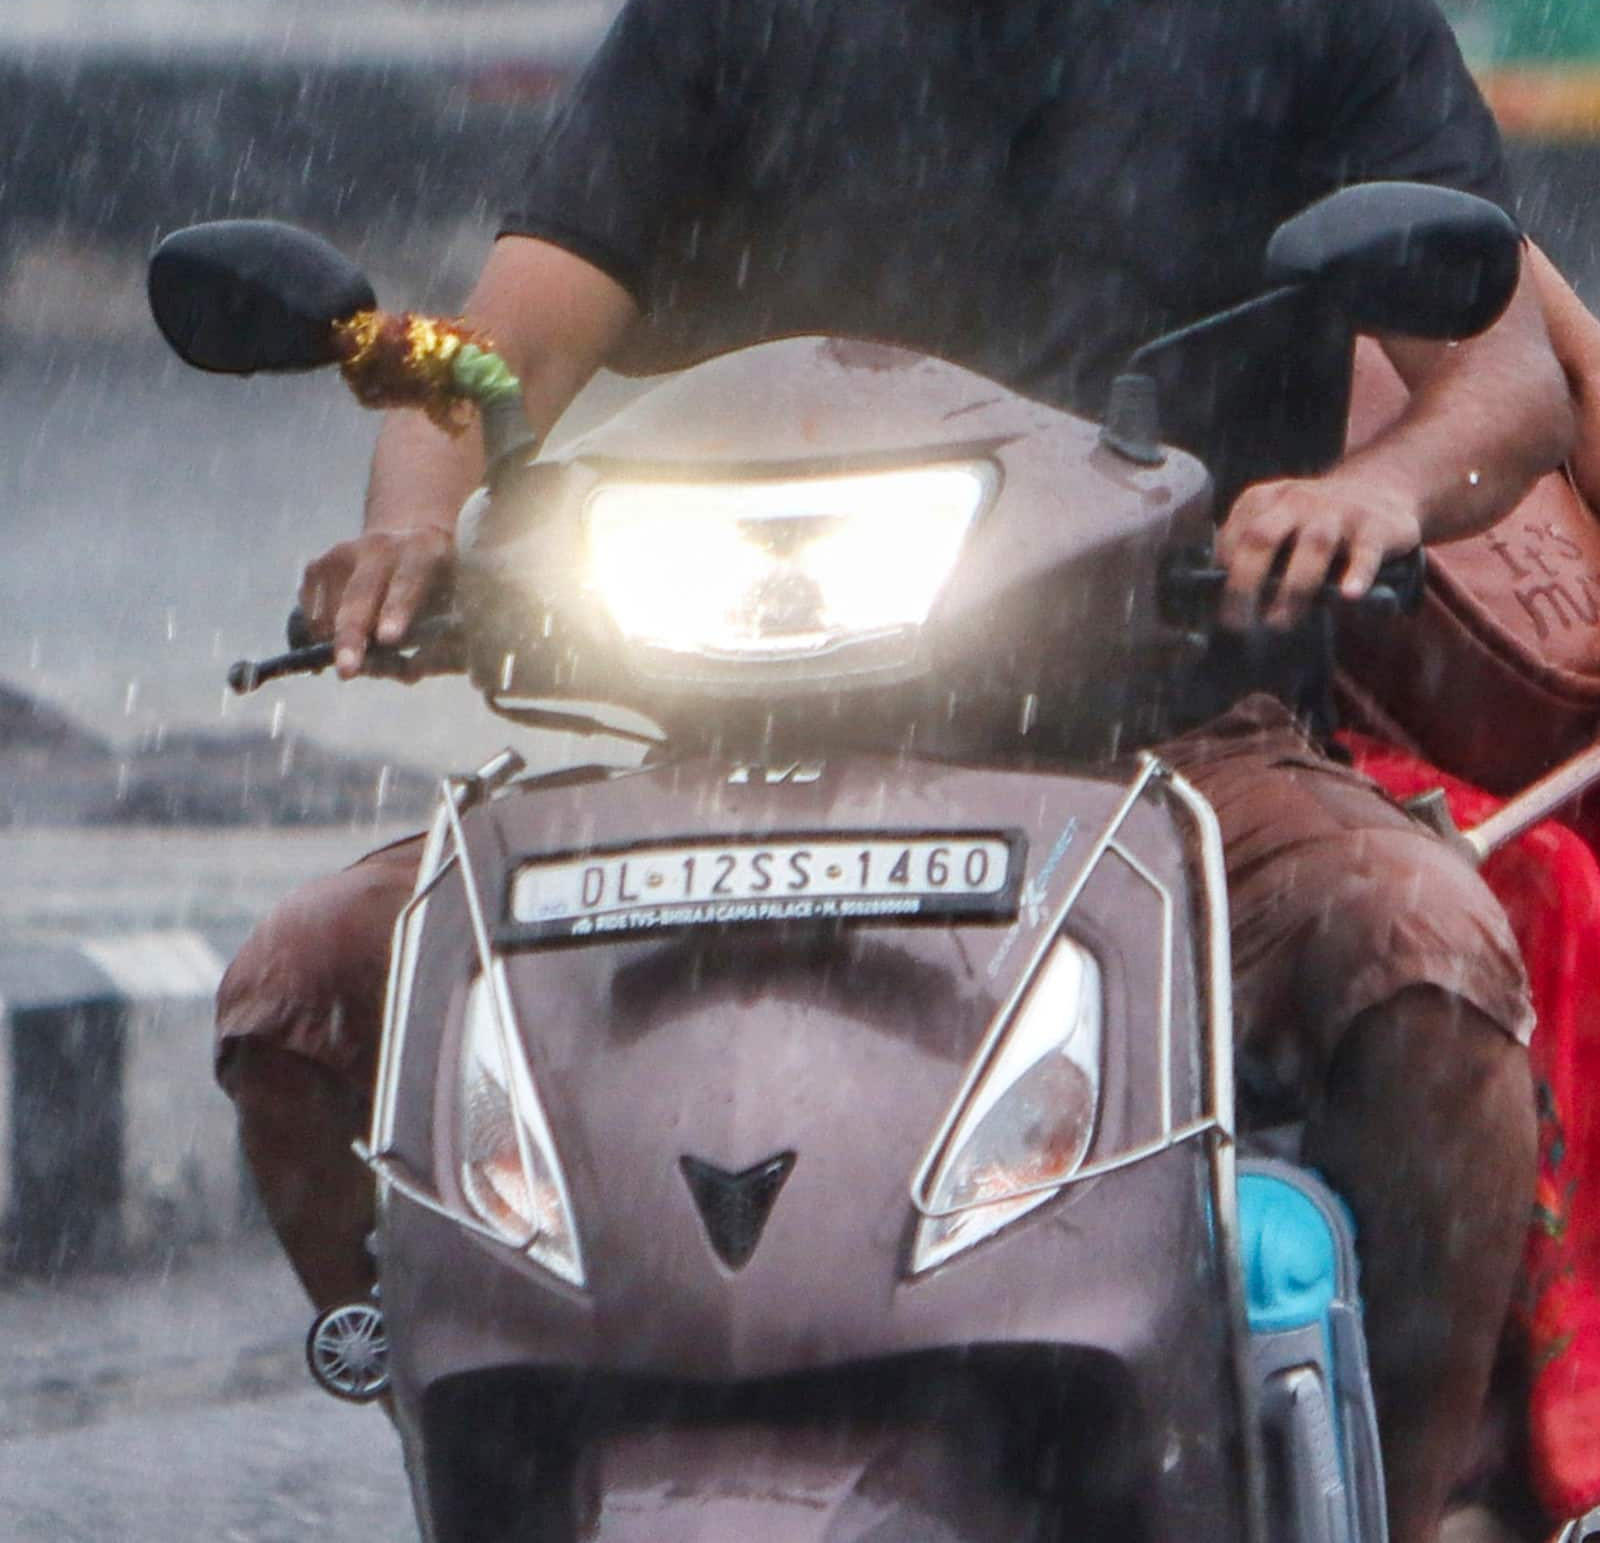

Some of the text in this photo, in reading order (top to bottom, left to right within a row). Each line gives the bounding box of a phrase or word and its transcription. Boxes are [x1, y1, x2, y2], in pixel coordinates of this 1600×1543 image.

[582, 847, 989, 907] DL 12SS 1460
